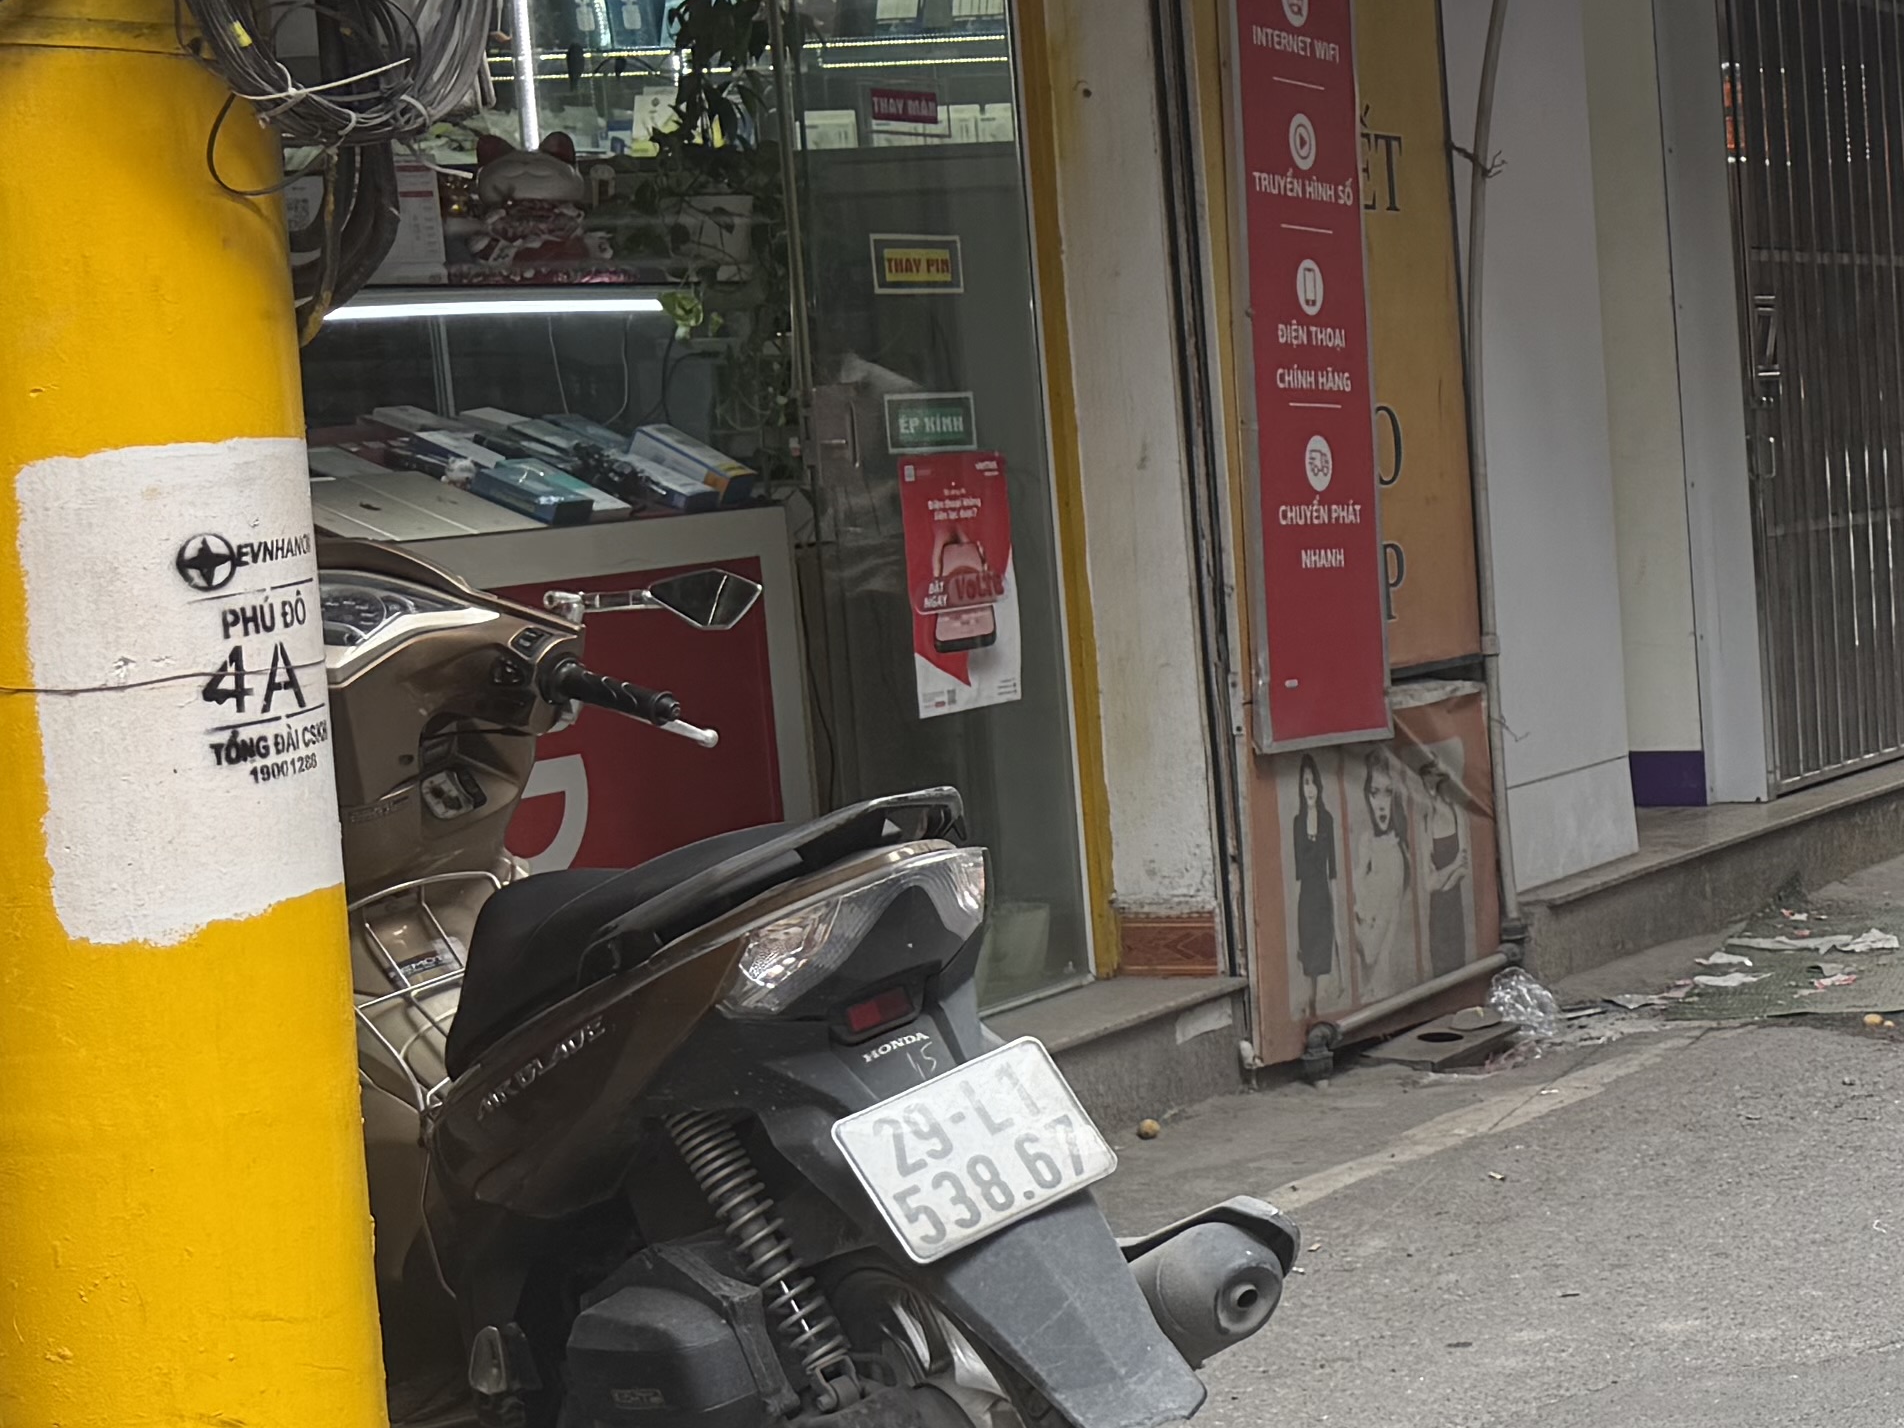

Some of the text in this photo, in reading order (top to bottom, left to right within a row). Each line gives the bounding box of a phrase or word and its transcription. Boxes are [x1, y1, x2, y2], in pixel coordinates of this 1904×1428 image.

[1252, 25, 1340, 64] INTERNET WIFI
[1305, 176, 1335, 204] HÌNH
[1338, 178, 1353, 206] SỐ
[886, 257, 949, 274] THAY PIN
[1278, 320, 1346, 351] ĐIỆN THOẠI
[1276, 364, 1315, 389] CHÍNH
[1331, 500, 1361, 524] PHÁT
[1301, 549, 1345, 569] NHANH
[222, 589, 307, 640] PHÚ ĐÔ
[210, 729, 271, 766] TỔNG
[273, 723, 300, 755] ĐÀI
[250, 753, 317, 784] 19001288
[862, 1030, 930, 1063] HONDA
[872, 1062, 1041, 1178] 29-L1
[892, 1114, 1086, 1245] 538.67
